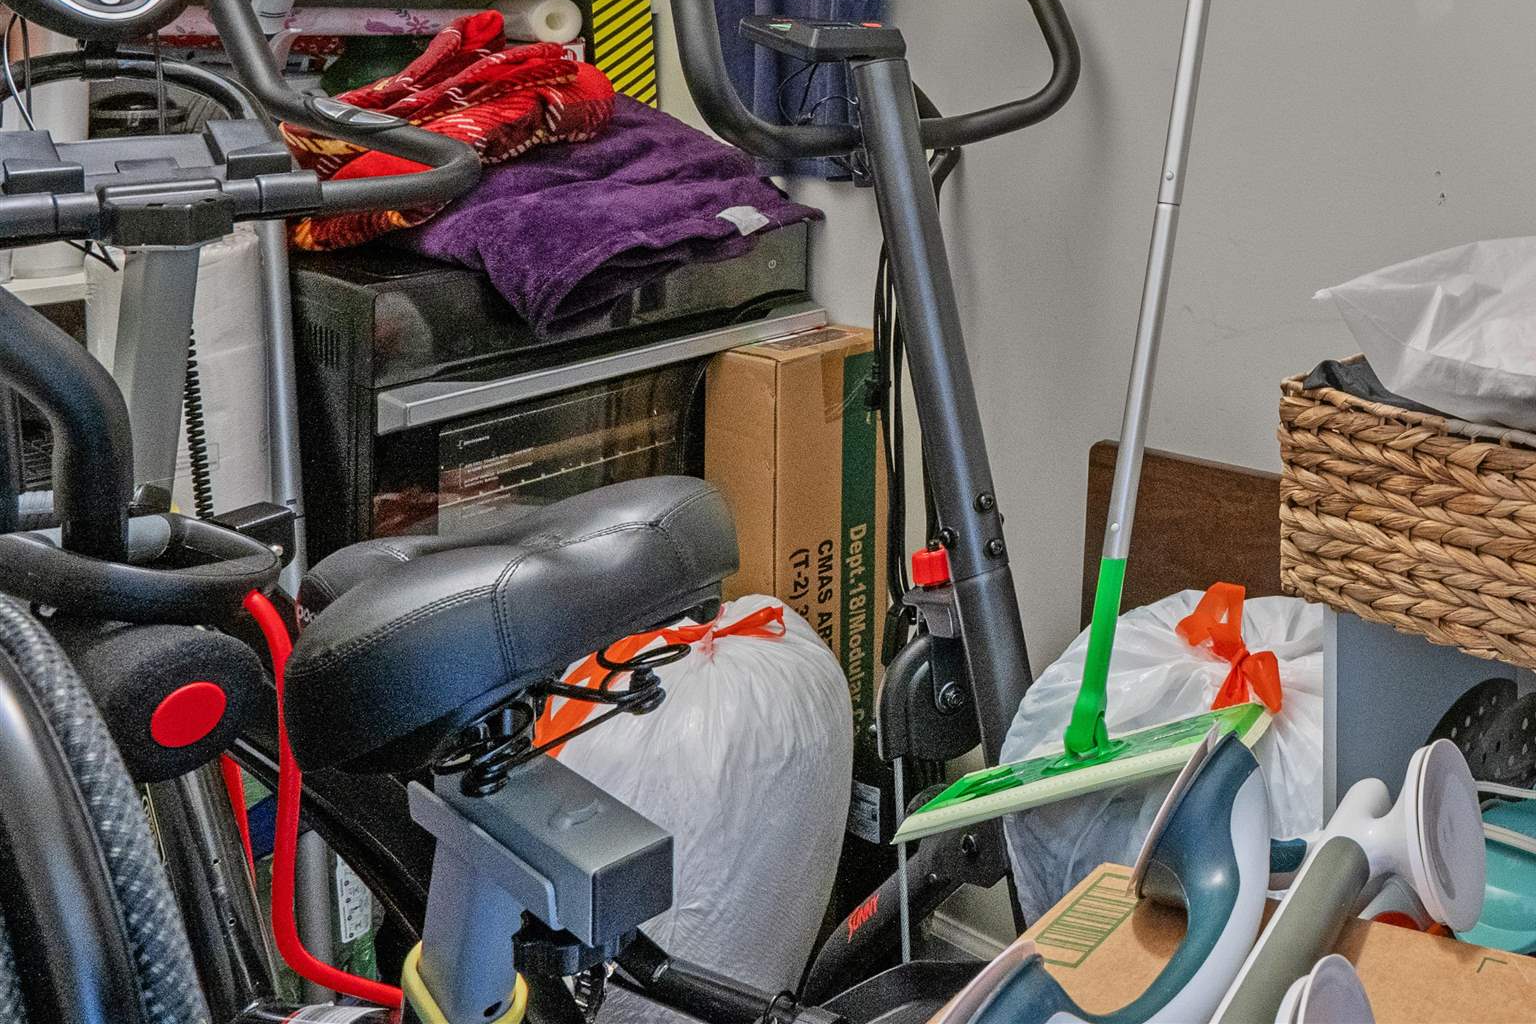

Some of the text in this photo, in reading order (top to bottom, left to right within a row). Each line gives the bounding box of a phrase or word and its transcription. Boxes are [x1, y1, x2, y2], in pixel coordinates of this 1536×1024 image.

[789, 547, 811, 600] (T-2)
[817, 538, 834, 605] CMAS
[845, 522, 867, 703] Dept.18/Modular
